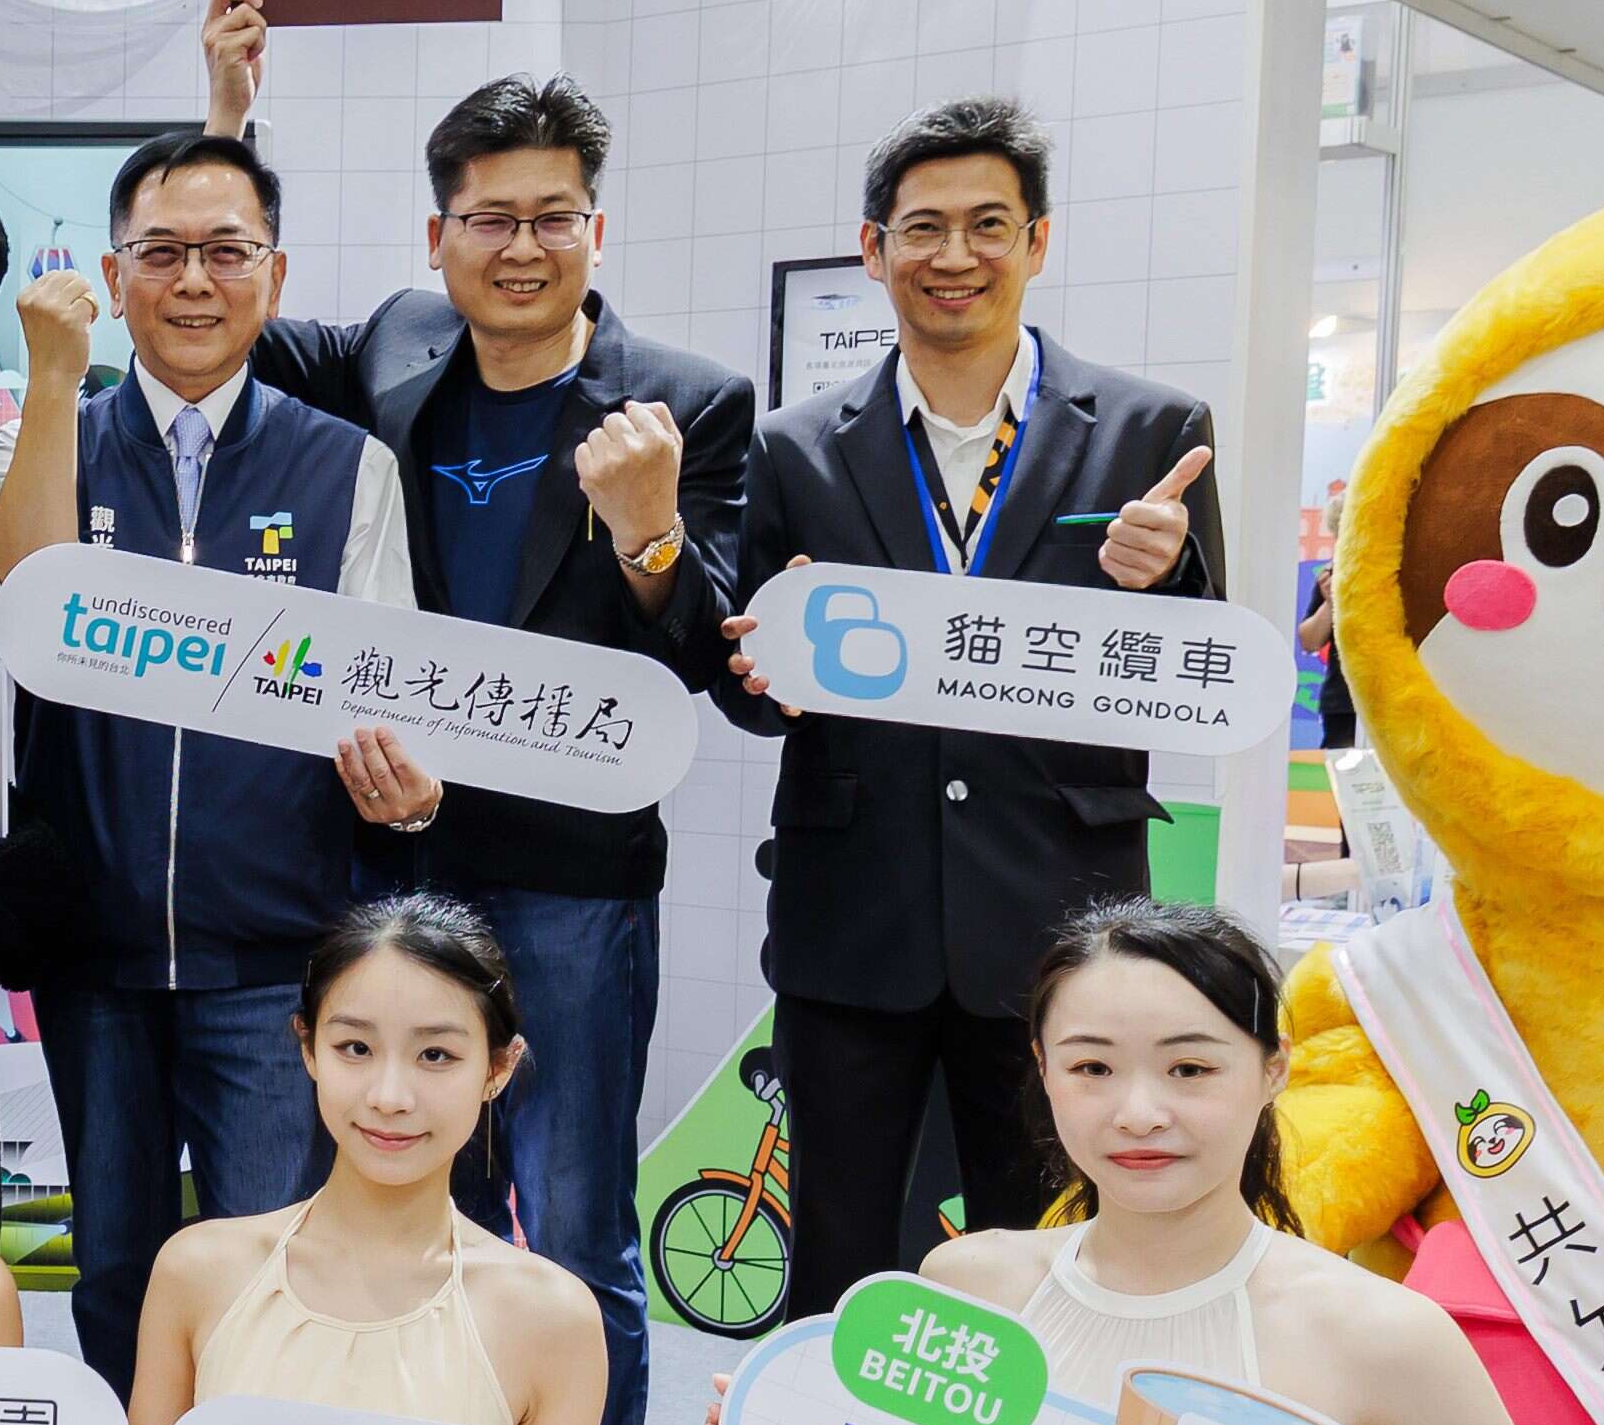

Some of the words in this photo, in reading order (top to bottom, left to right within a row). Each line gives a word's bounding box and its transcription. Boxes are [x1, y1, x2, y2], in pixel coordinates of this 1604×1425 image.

[819, 328, 896, 350] TAiPE
[244, 557, 297, 573] TAIPEI
[61, 592, 227, 678] taipei
[91, 595, 232, 636] undiscovered
[56, 651, 131, 677] 你所未見的台北
[944, 612, 1238, 689] 貓空纜車
[253, 675, 324, 706] TAIPEI
[340, 646, 634, 751] 觀光傳播局
[937, 677, 1076, 709] MAOKONG
[1093, 694, 1231, 727] GONDOLA
[340, 699, 425, 727] Department
[426, 716, 444, 736] of
[444, 721, 529, 747] Information
[530, 740, 562, 754] and
[564, 744, 623, 767] Tourism
[889, 1305, 1002, 1386] 北投
